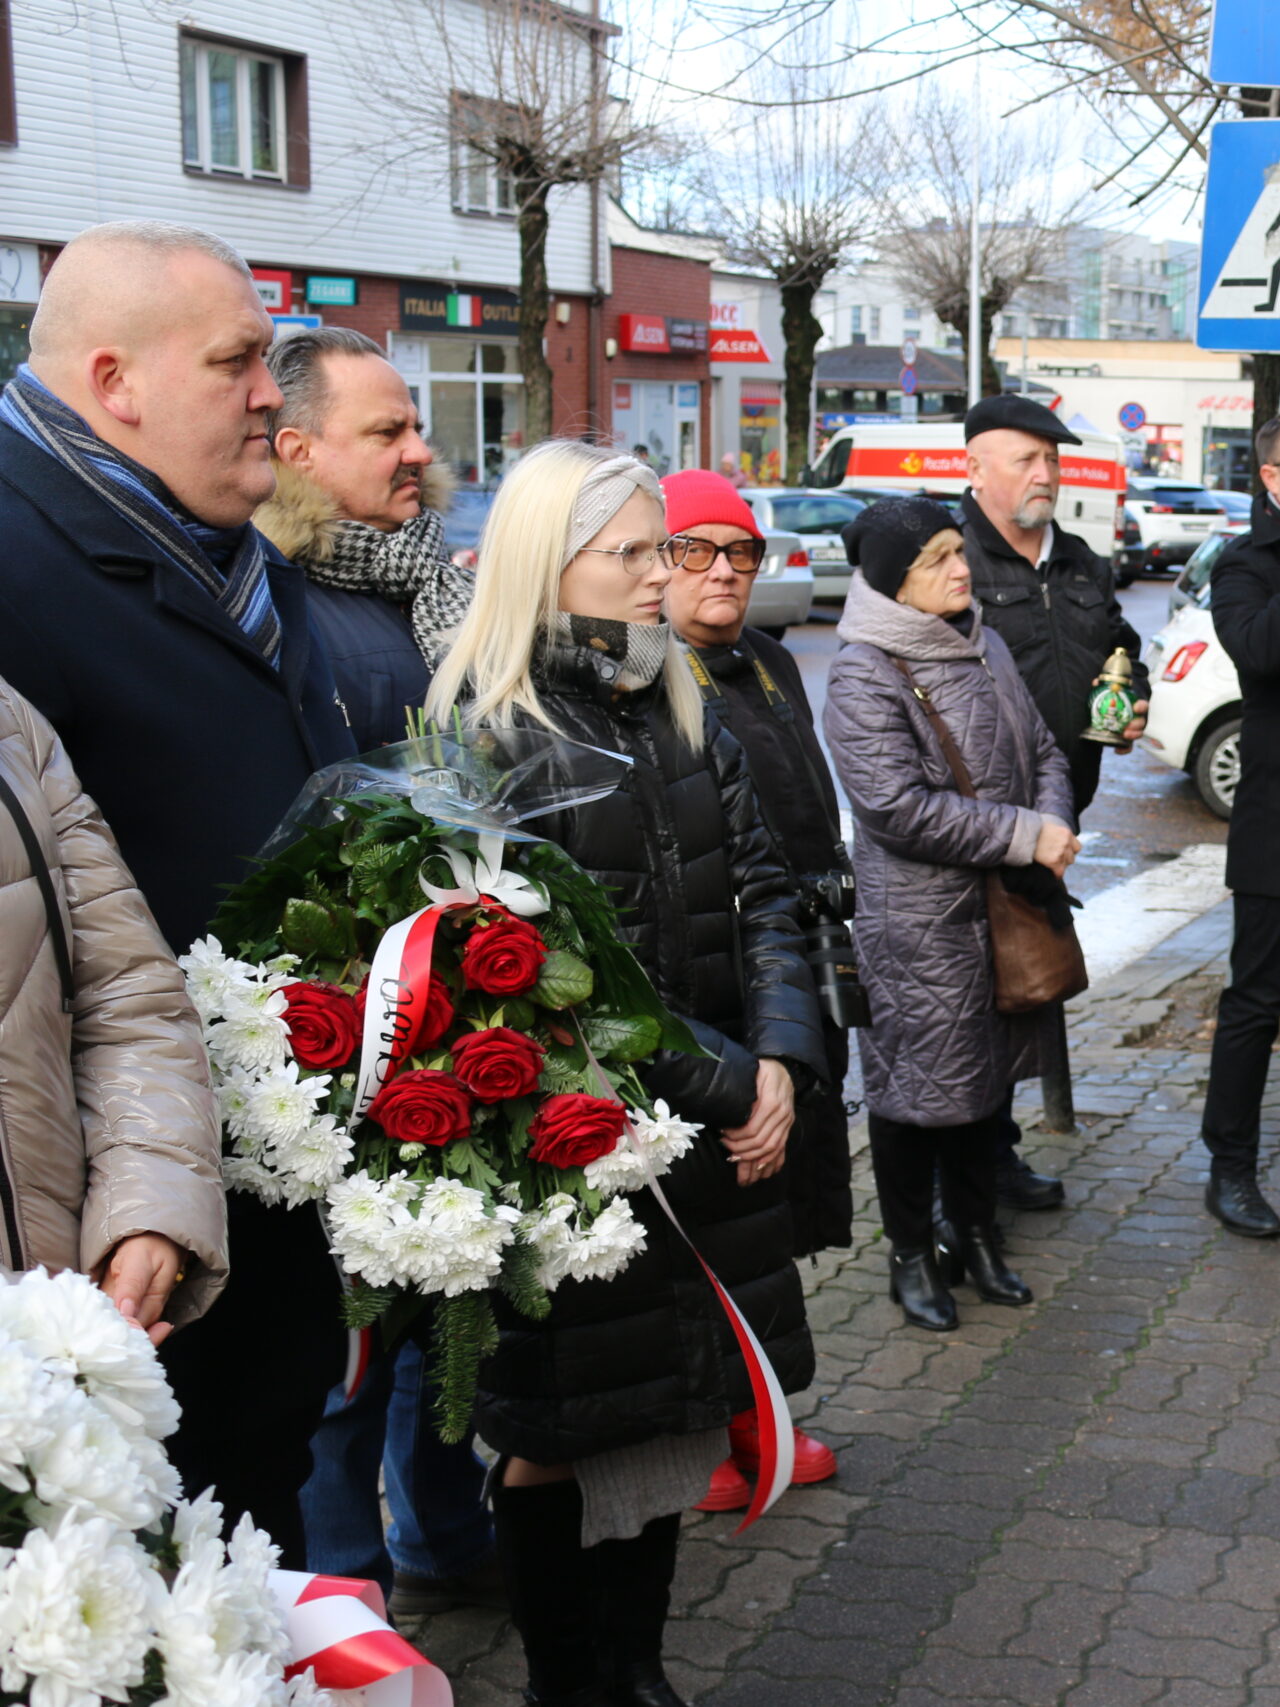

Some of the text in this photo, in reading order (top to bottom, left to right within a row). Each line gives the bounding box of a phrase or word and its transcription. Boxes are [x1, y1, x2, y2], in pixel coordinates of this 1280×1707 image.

[403, 298, 521, 321] ITALIA OUTLE
[632, 323, 667, 345] ALSEN
[711, 338, 761, 354] ALSEN
